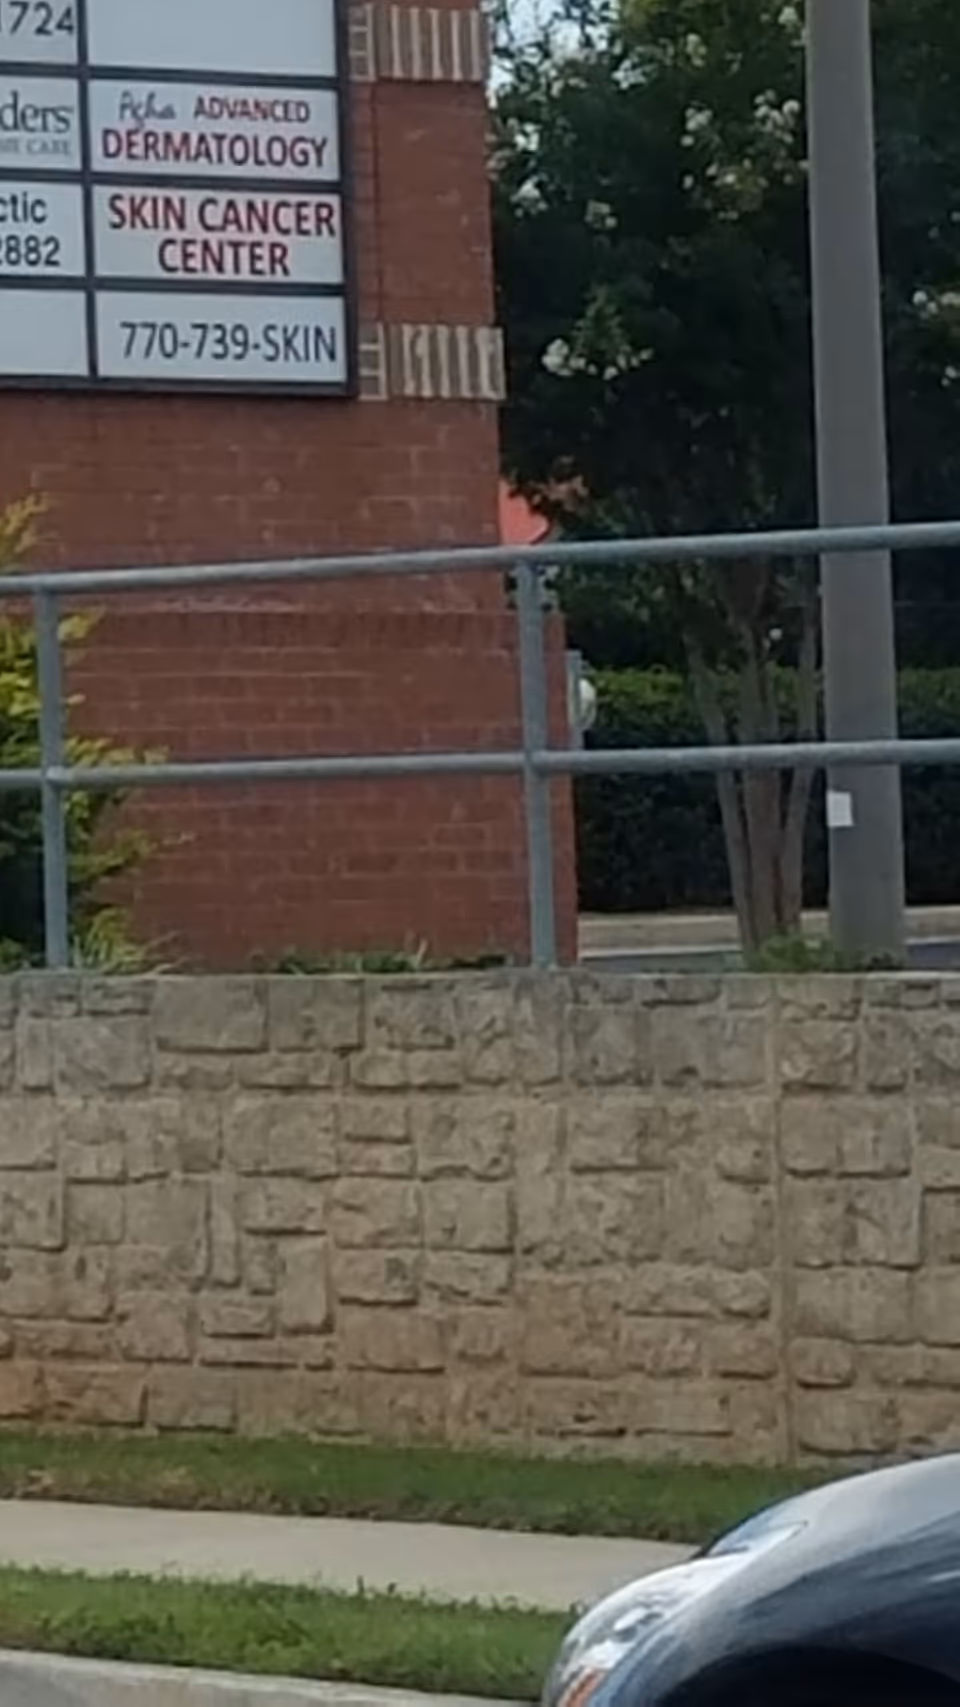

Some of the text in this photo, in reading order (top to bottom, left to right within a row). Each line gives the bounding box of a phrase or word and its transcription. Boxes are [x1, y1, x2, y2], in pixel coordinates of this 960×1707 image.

[193, 96, 311, 123] ADVANCED
[102, 128, 327, 168] DERMATOLOGY
[109, 193, 336, 237] SKIN CANCER
[158, 238, 290, 277] CENTER
[119, 320, 336, 363] 770-739-SKIN
